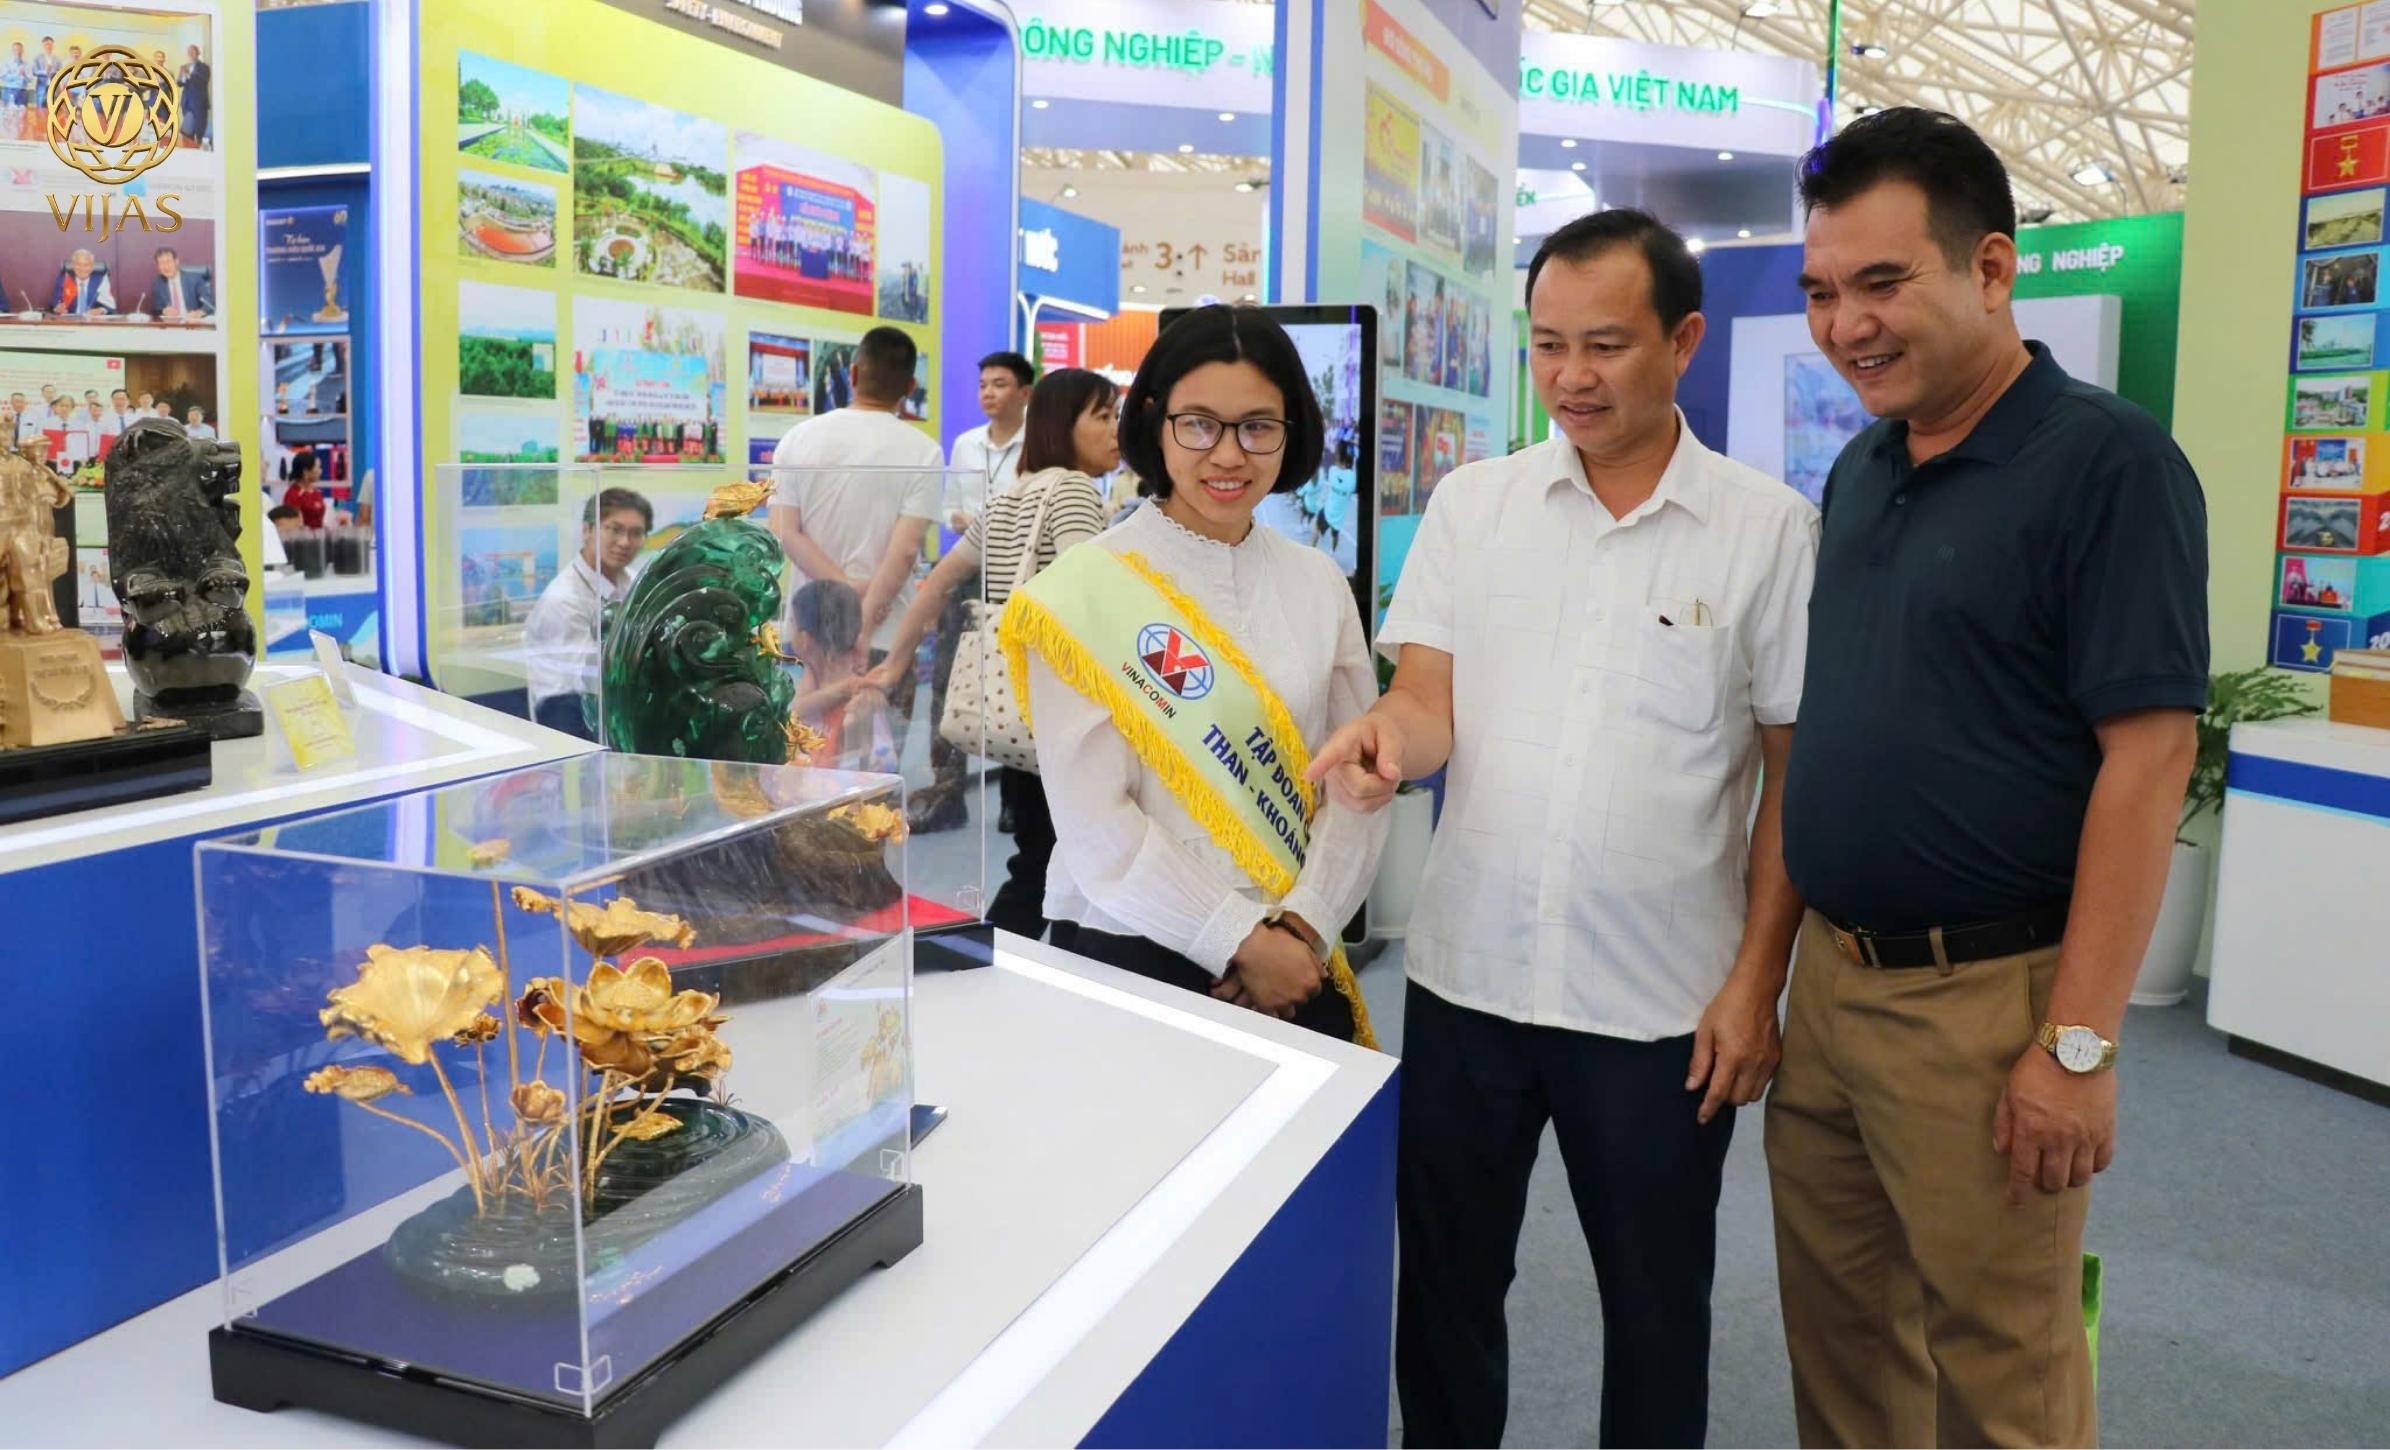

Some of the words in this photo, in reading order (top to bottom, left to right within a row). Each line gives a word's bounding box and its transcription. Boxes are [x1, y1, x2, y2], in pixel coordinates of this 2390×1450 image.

[1018, 17, 1094, 57] ÔNG
[1104, 30, 1224, 76] NGHIỆP
[1551, 69, 1599, 101] GIA
[1607, 69, 1671, 111] VIỆT
[1677, 81, 1738, 113] NAM
[1154, 242, 1174, 269] 3
[2052, 241, 2124, 273] NGHIỆP
[1222, 271, 1257, 286] Hall
[1121, 661, 1177, 719] VINACOMIN
[1202, 723, 1249, 786] THAN
[1245, 726, 1277, 767] TẬP
